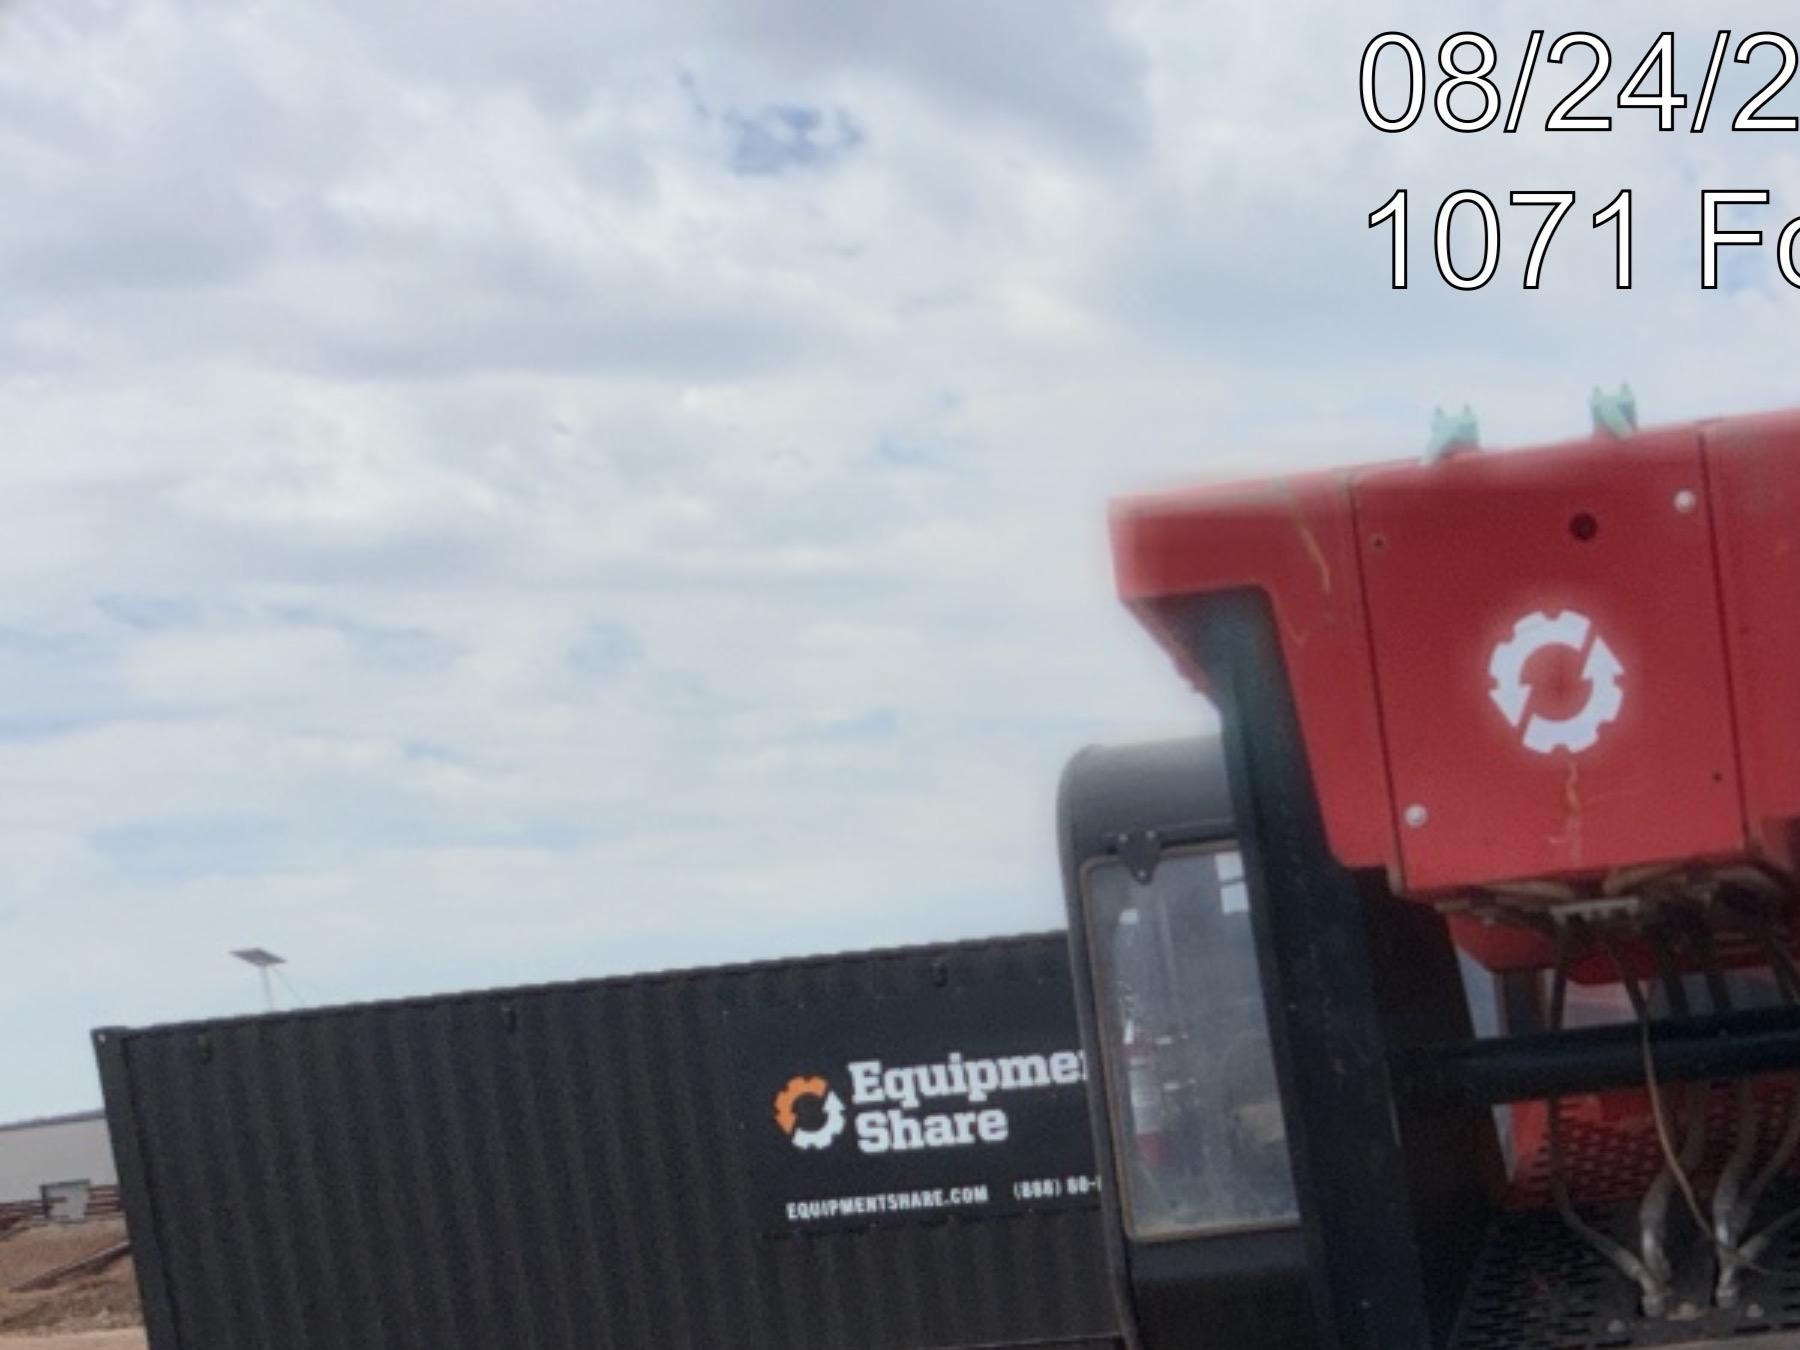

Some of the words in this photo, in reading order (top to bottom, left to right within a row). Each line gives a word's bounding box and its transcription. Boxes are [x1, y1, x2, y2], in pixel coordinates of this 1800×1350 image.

[847, 1049, 1088, 1110] Equipme
[855, 1107, 1010, 1154] Share
[786, 1184, 990, 1220] EQUIPMENTSHARE.COM
